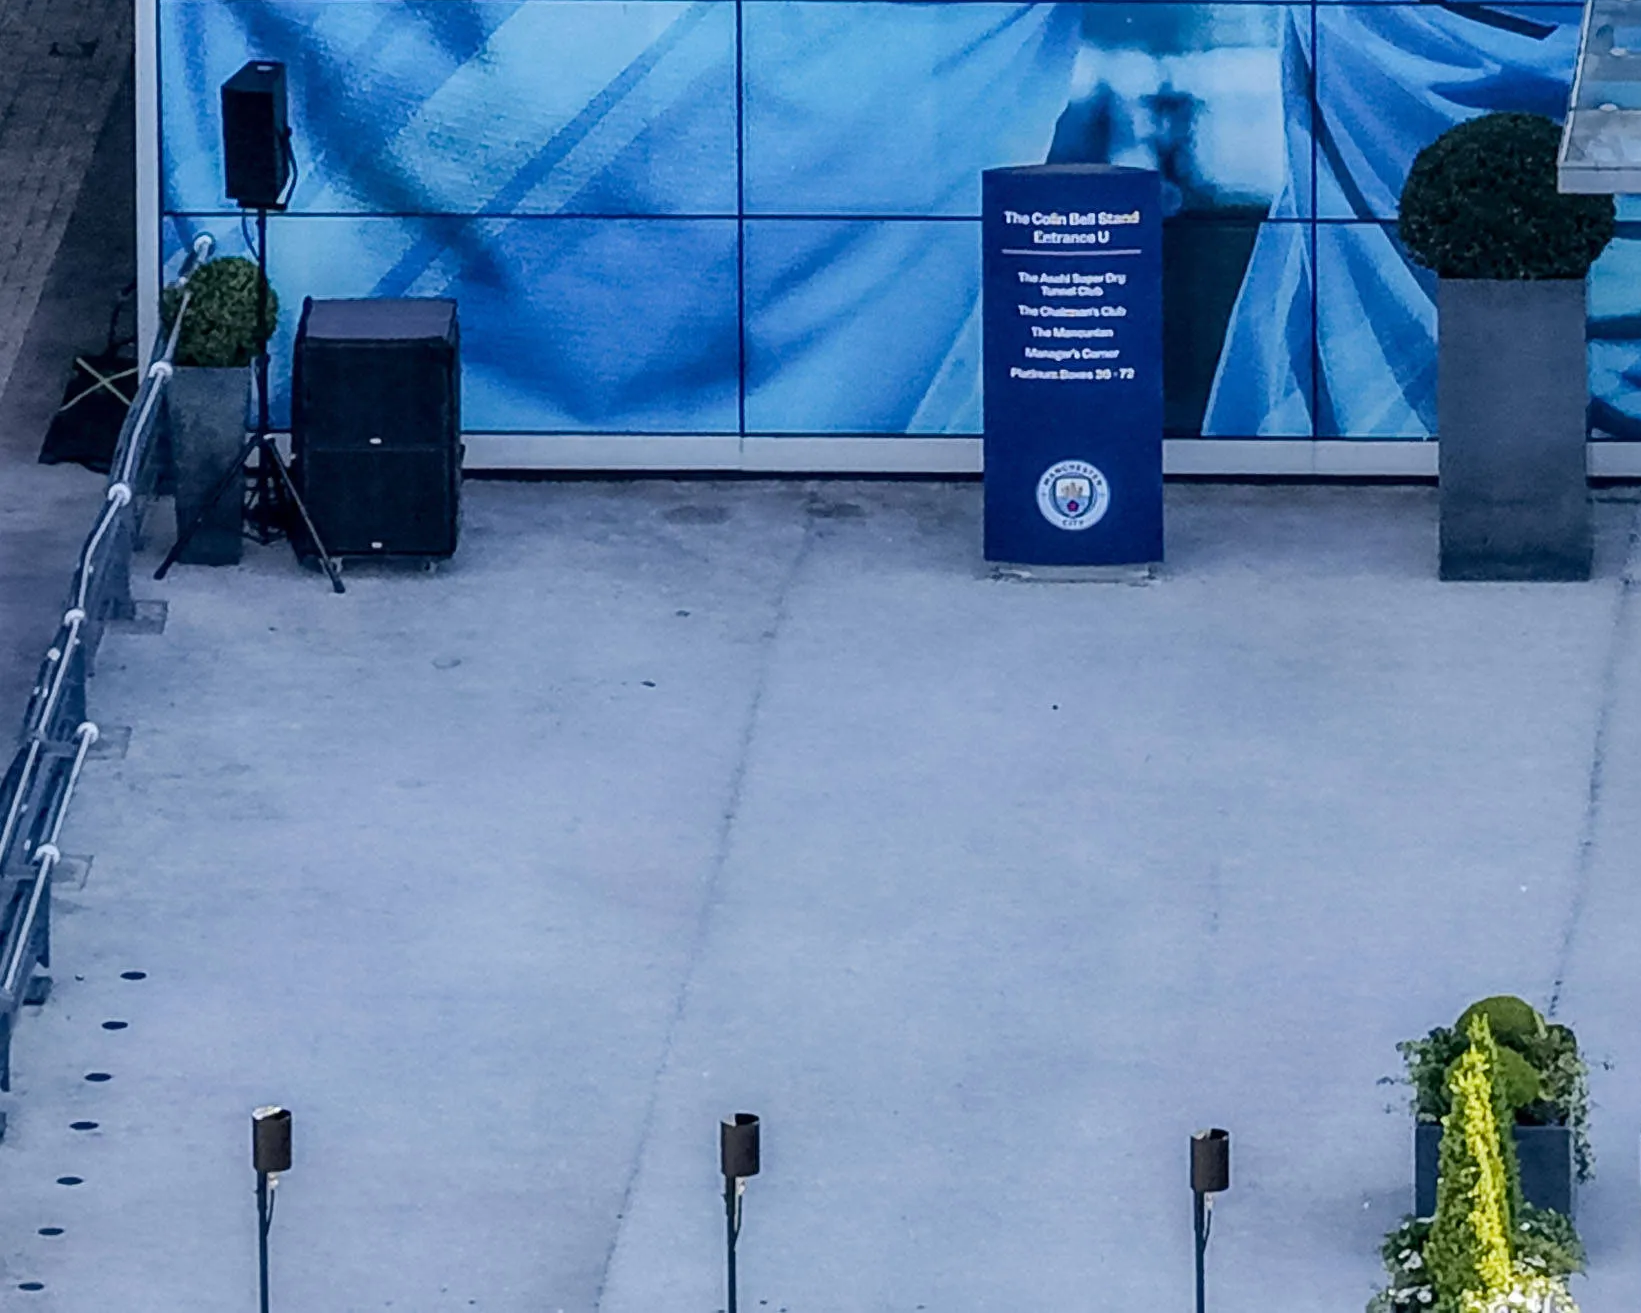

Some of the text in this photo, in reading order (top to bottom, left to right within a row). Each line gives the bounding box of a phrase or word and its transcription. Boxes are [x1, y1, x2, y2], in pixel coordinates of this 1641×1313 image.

[1004, 211, 1140, 225] The Colin Bell Stand
[1034, 230, 1110, 244] Entrance U
[1018, 272, 1038, 283] The
[1018, 305, 1038, 316] The
[1031, 326, 1051, 337] The
